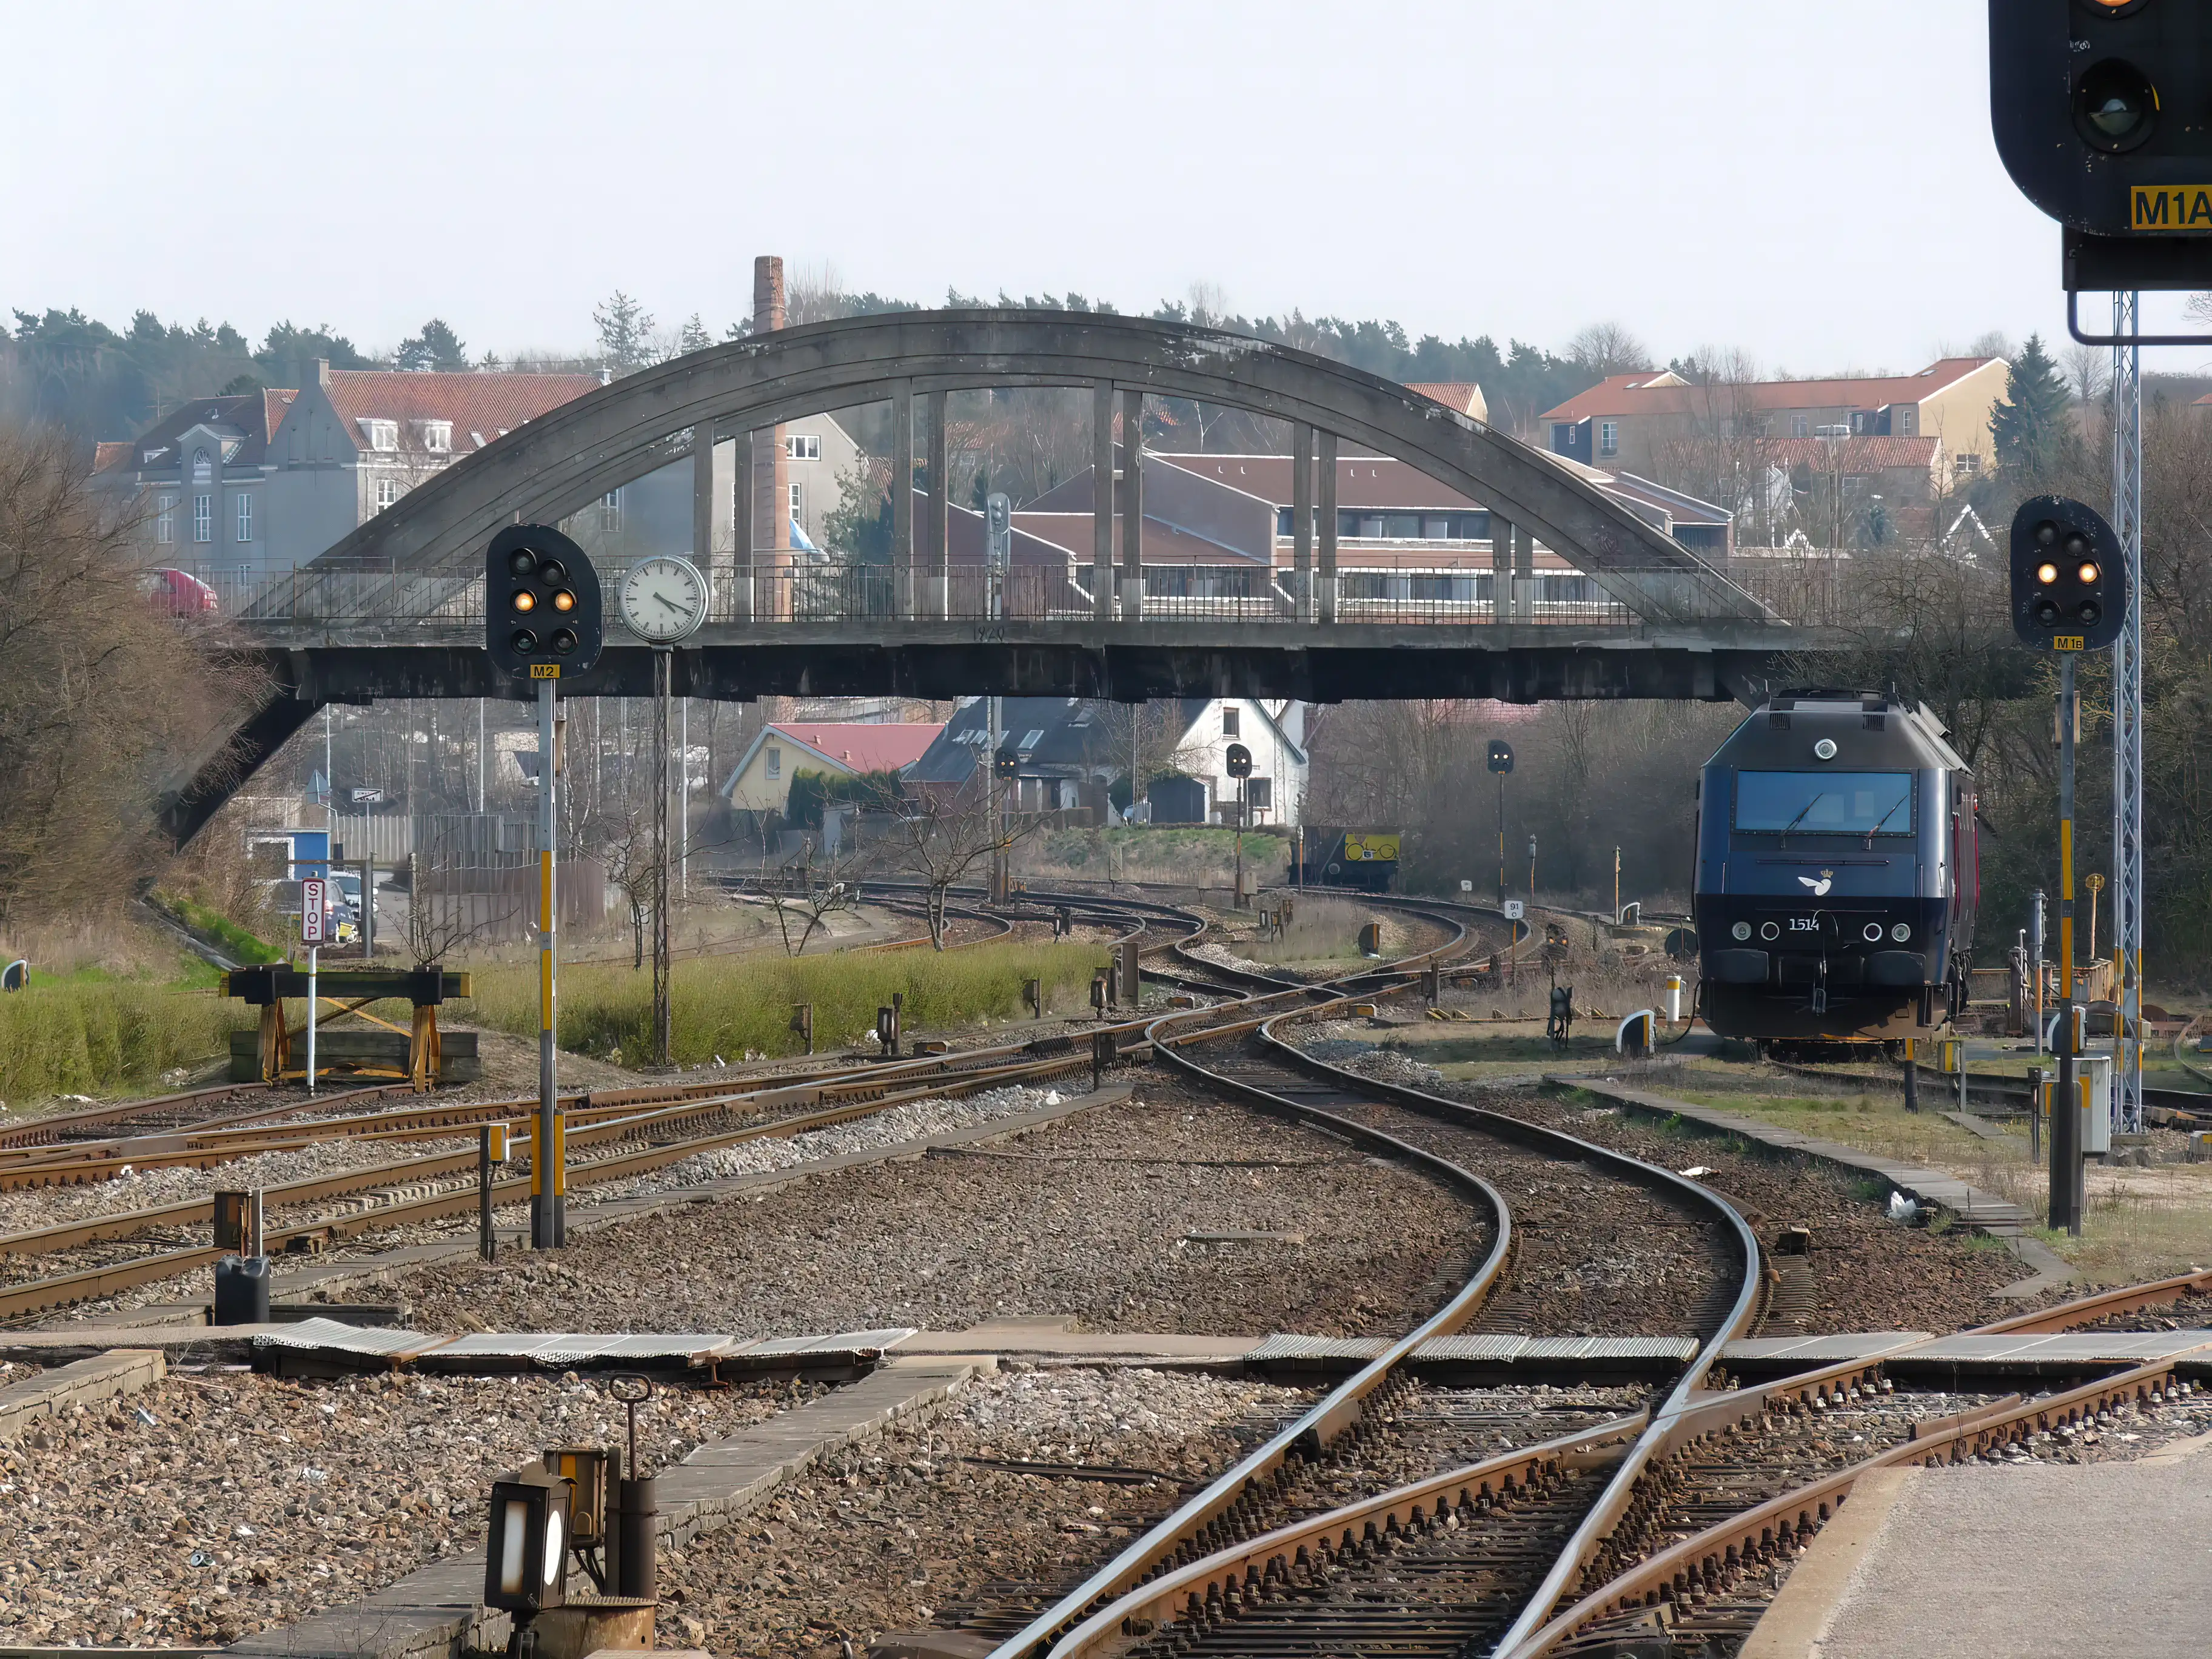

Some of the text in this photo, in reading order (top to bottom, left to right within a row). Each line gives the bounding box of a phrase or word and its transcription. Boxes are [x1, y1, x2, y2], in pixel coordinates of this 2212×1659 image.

[2136, 191, 2212, 224] M1A
[2057, 637, 2082, 649] M1B
[534, 666, 554, 677] M2
[307, 883, 318, 939] STOP
[1789, 918, 1819, 931] 1514
